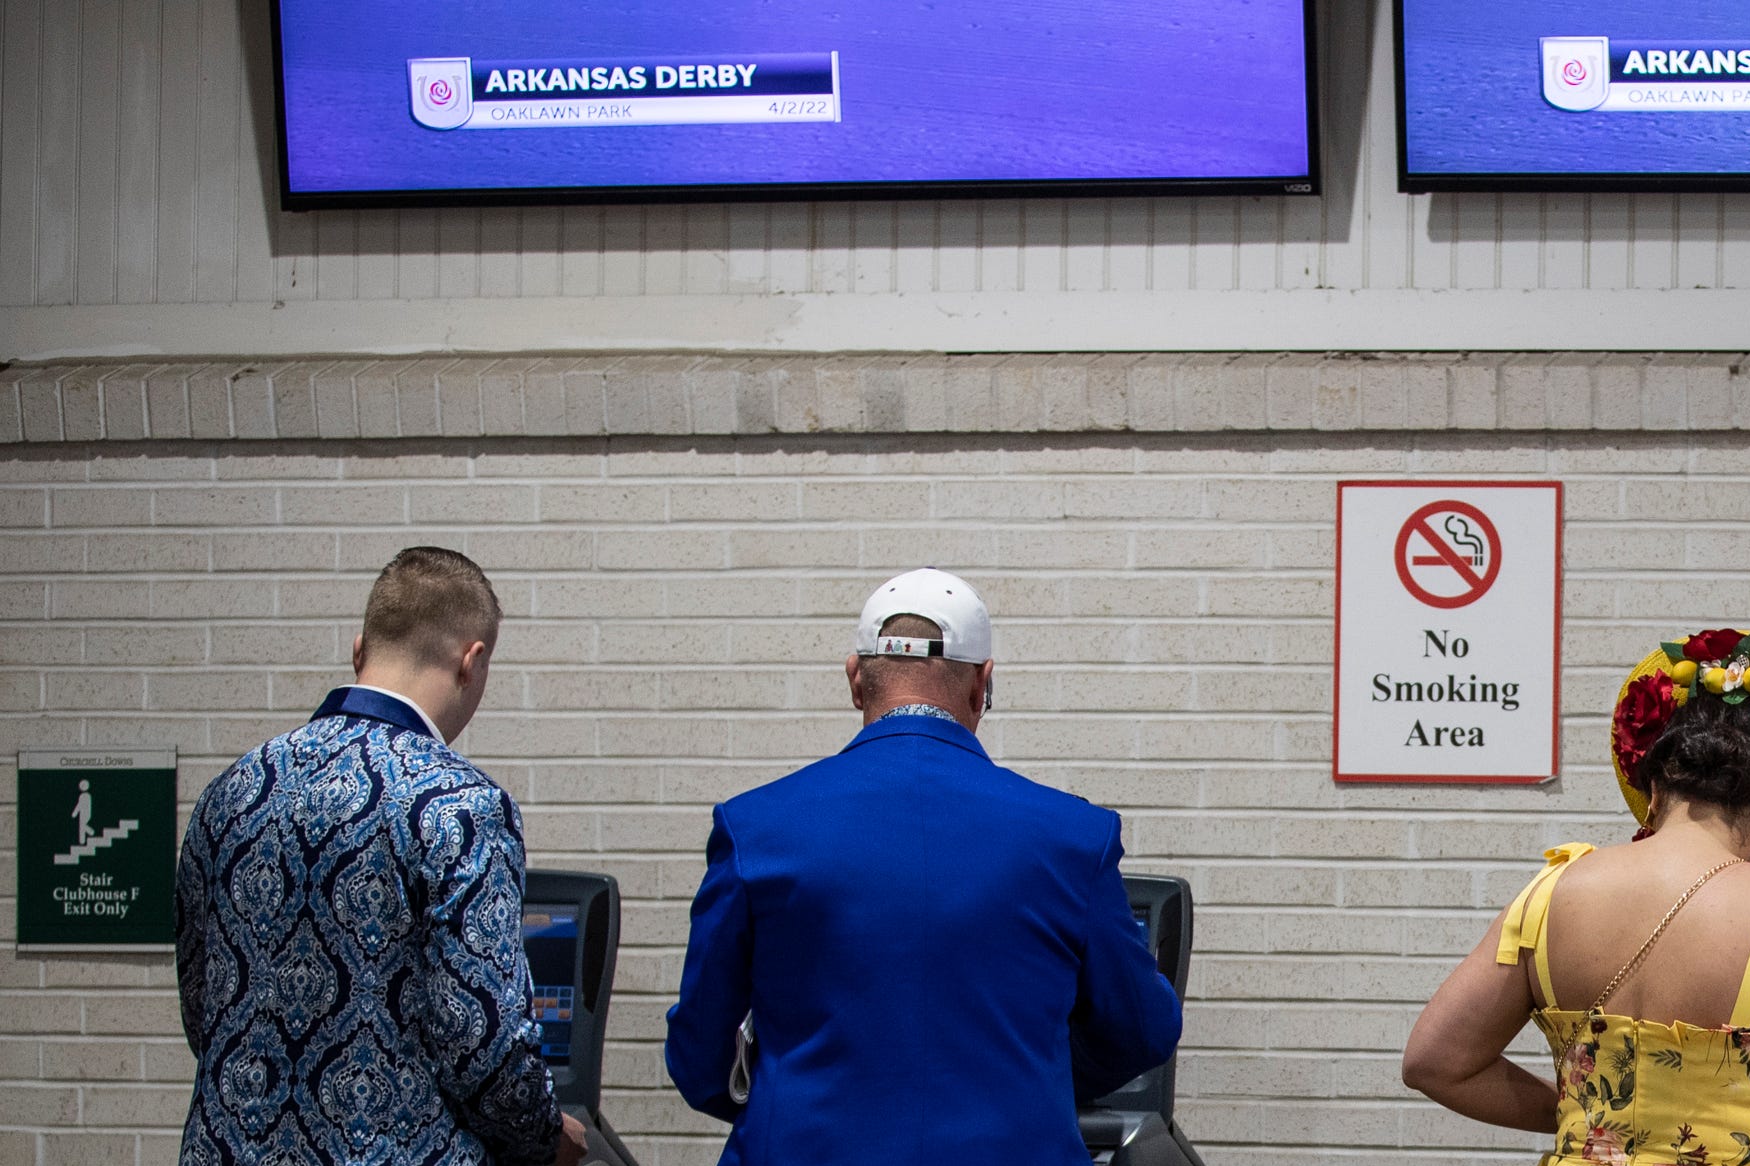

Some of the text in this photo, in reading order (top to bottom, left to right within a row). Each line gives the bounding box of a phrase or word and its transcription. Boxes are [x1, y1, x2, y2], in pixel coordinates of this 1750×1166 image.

[485, 64, 757, 93] ARKANSAS DERBY
[1628, 90, 1724, 103] OAKLAWN
[491, 104, 632, 120] OAKLAWN PARK
[768, 101, 827, 114] 4/2/22
[1423, 629, 1469, 658] No
[1371, 673, 1520, 711] Smoking
[1404, 719, 1485, 747] Area
[80, 872, 113, 886] Stair
[53, 887, 140, 900] Clubhouse F
[64, 902, 129, 919] Exit Only
